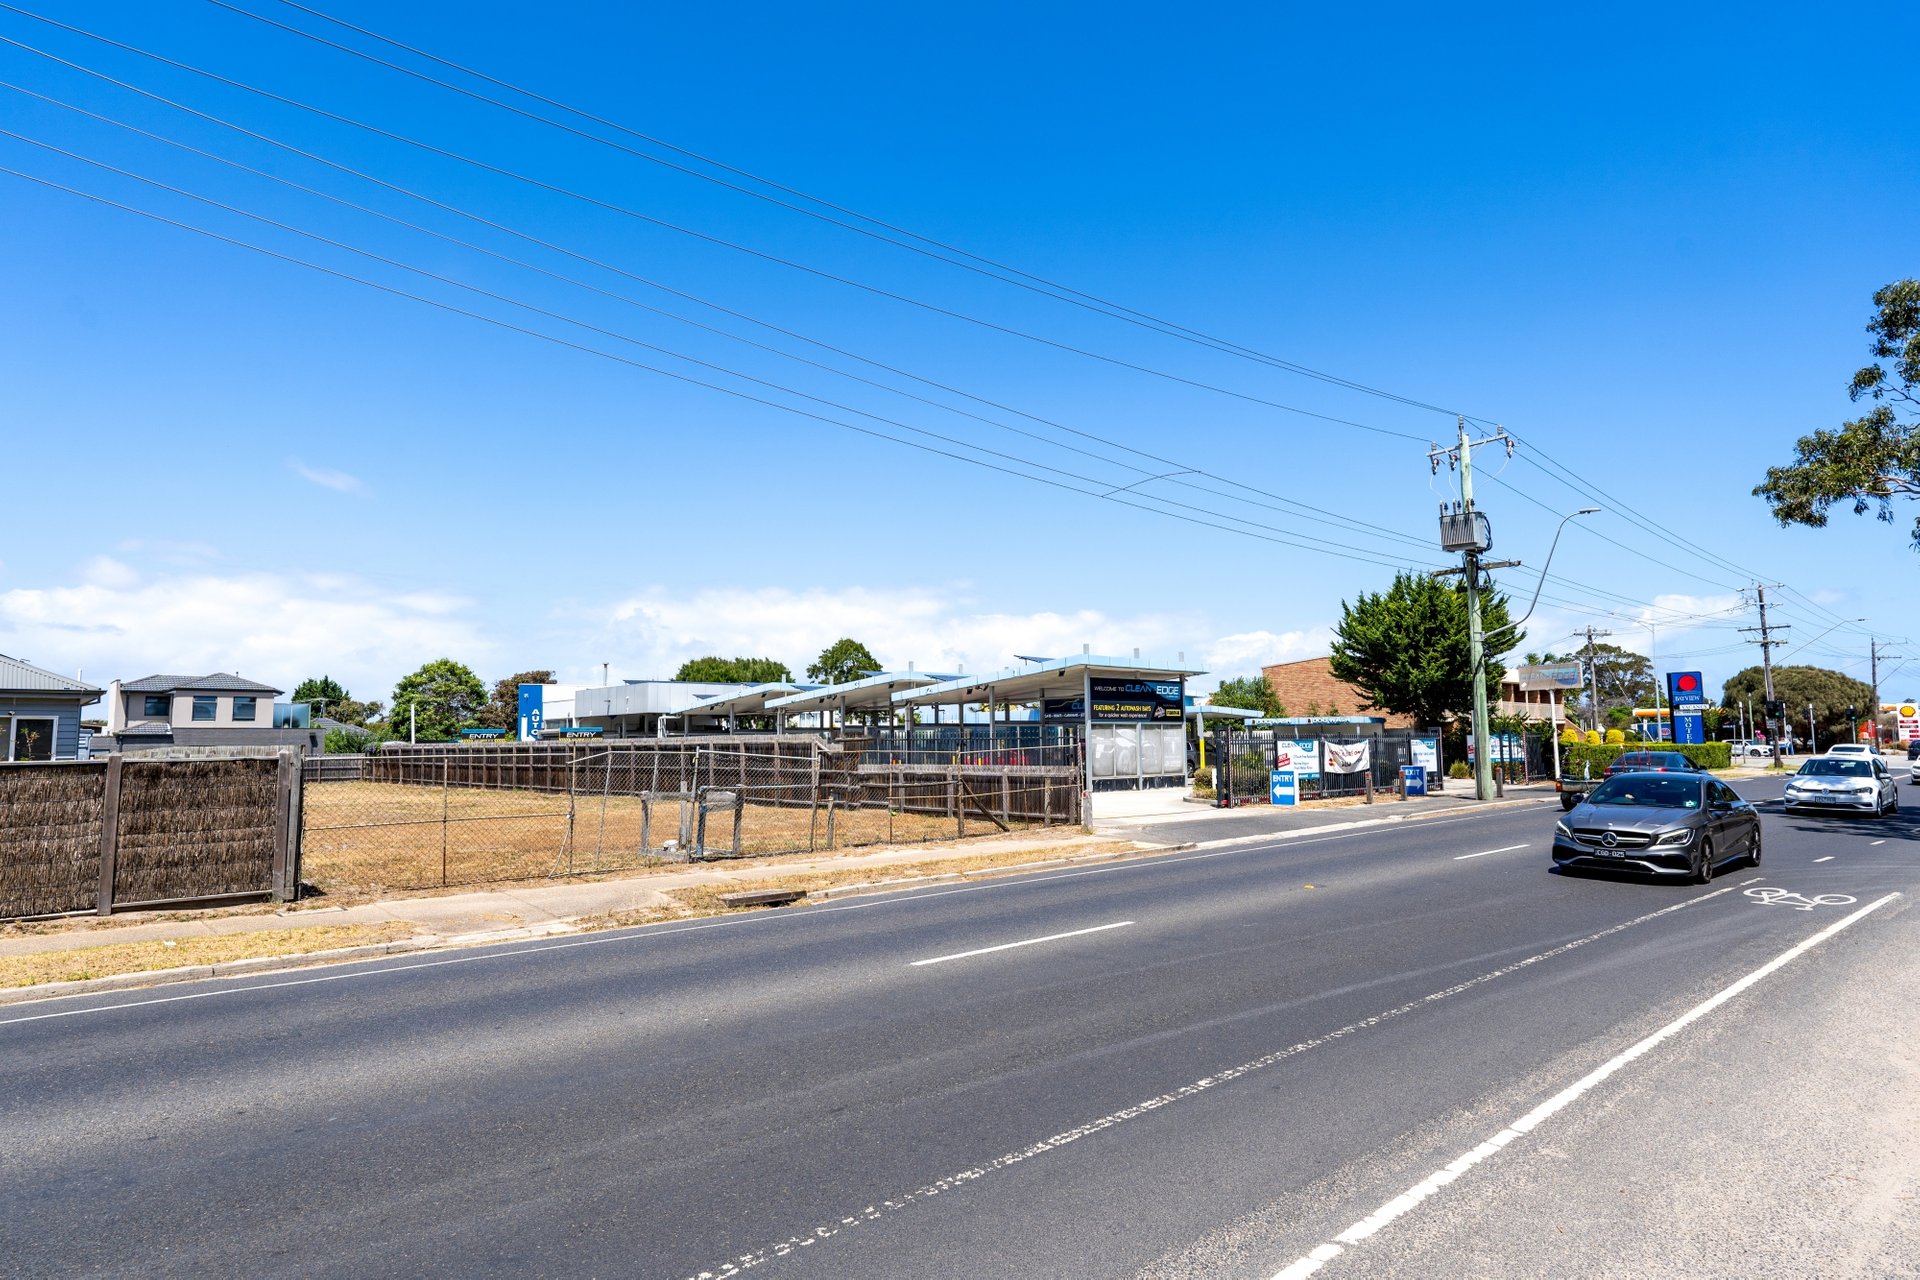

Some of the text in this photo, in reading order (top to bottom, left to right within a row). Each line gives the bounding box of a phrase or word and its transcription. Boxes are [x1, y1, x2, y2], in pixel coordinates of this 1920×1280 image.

[1125, 684, 1152, 692] CLEAN
[1156, 685, 1179, 695] EDGE
[1116, 703, 1120, 711] 2
[1684, 717, 1693, 744] MOTEL
[1272, 774, 1294, 782] ENTRY
